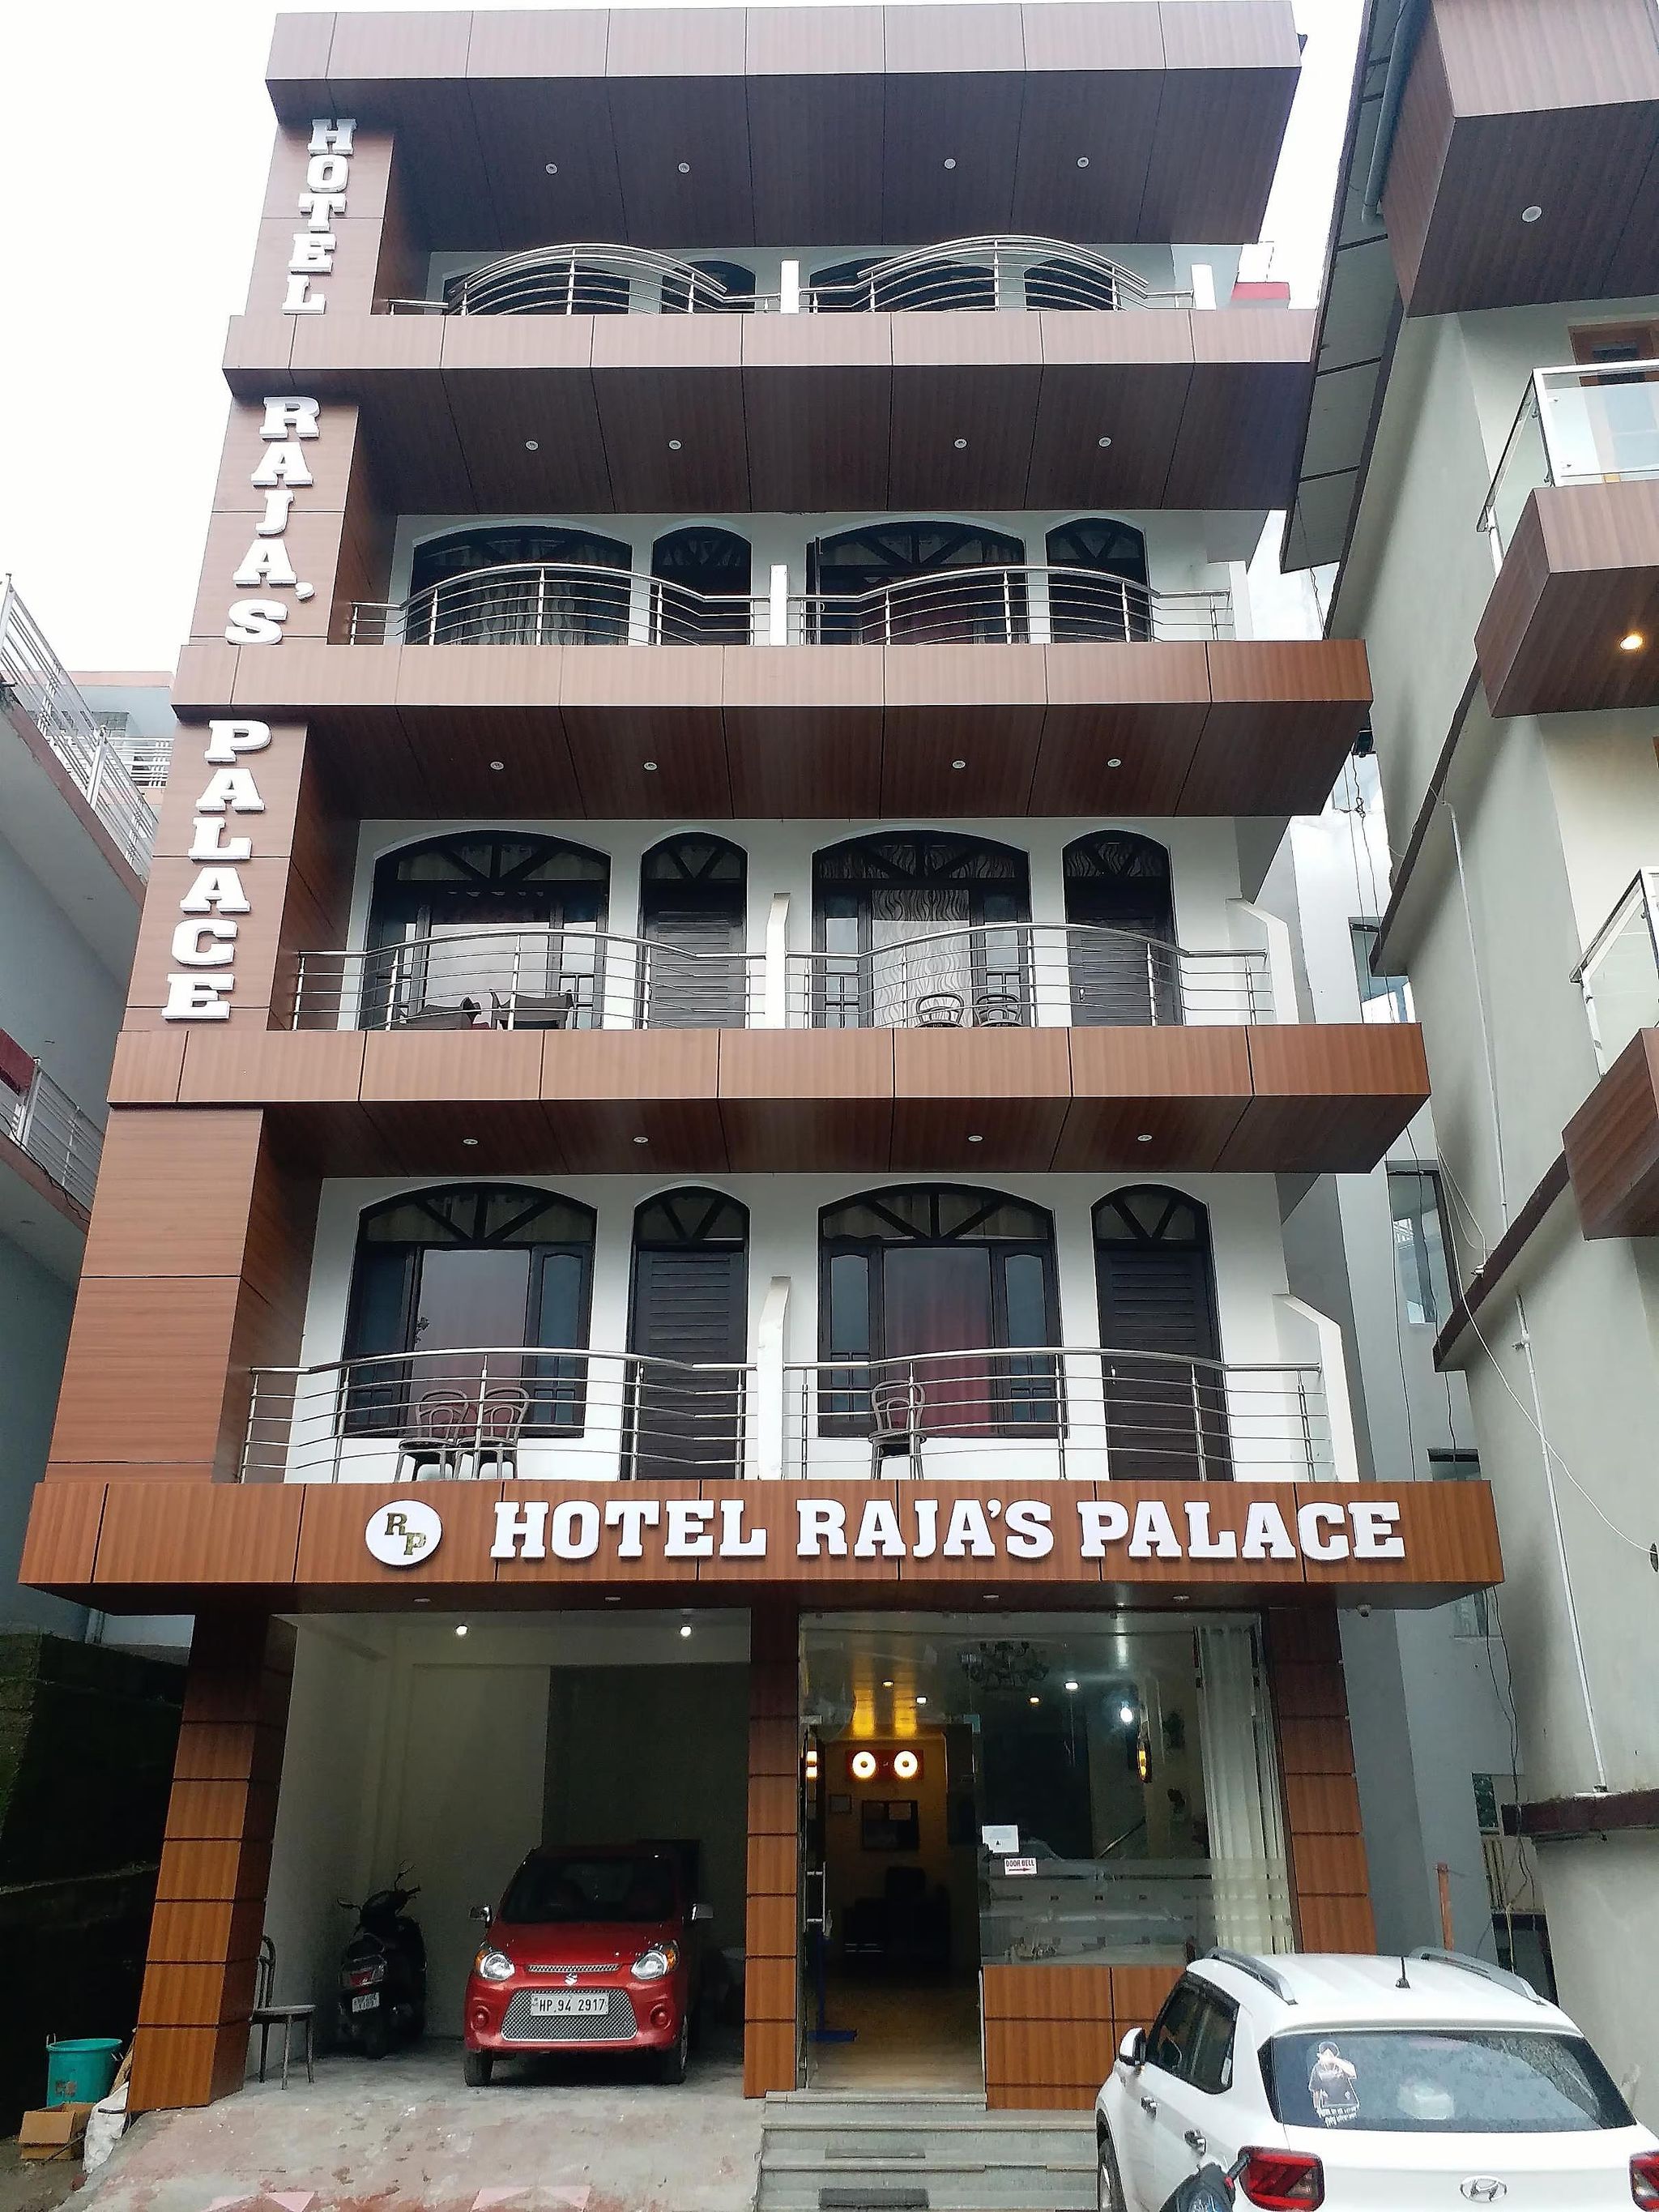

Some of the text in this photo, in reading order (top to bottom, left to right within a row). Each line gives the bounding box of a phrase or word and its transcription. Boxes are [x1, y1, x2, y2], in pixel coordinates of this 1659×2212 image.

[281, 117, 358, 315] HOTEL
[225, 395, 320, 645] RAJA'S
[161, 720, 272, 1021] PALACE
[489, 1497, 1406, 1561] HOTEL RAJA'S PALACE
[1005, 1859, 1035, 1868] DOOR BELL
[578, 1998, 605, 2011] 2917
